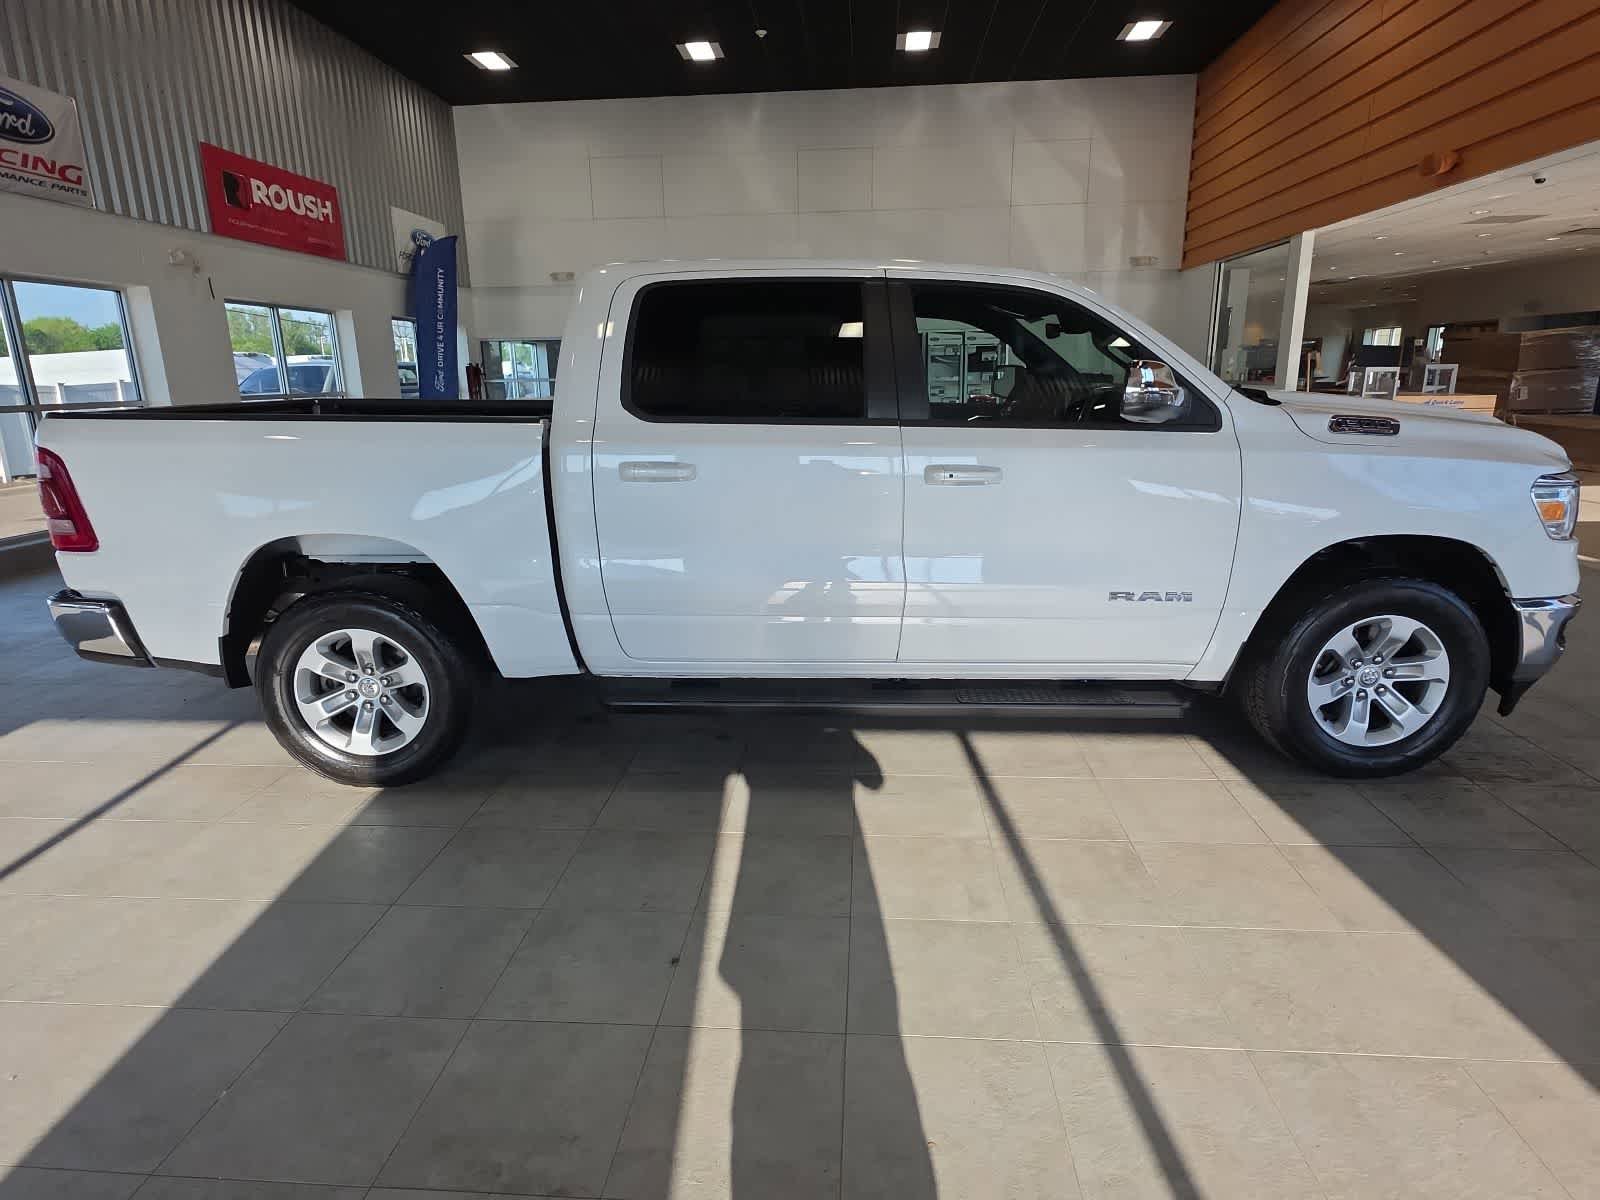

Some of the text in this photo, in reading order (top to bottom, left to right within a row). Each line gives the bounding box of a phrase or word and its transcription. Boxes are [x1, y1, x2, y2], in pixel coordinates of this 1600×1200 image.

[0, 97, 36, 136] rd
[51, 183, 88, 197] PARTS
[250, 178, 334, 224] ROUSH
[436, 267, 445, 320] CMMUNITY
[436, 321, 444, 334] UR
[436, 342, 445, 367] DRIVE
[1108, 591, 1192, 602] RAM
